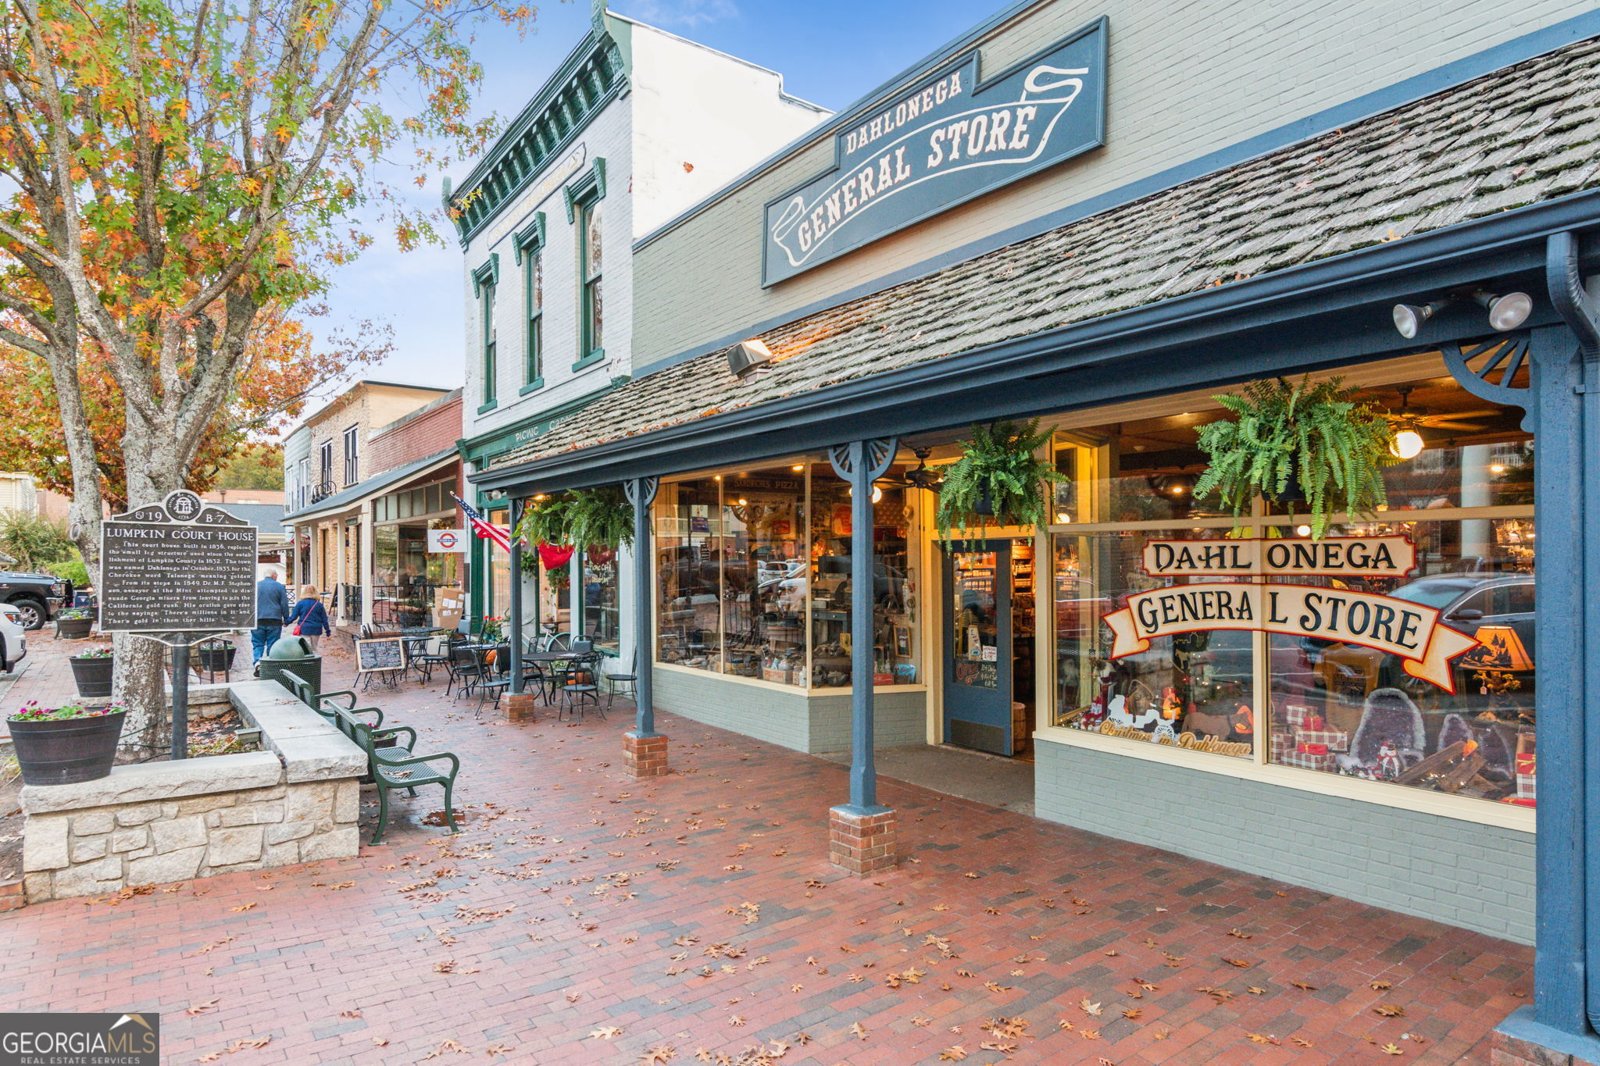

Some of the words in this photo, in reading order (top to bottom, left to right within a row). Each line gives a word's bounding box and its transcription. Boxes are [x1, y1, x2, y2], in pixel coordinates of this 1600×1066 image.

[847, 71, 962, 156] DAHLONEGA
[798, 147, 911, 252] GENERAL
[927, 106, 1038, 169] STORE
[515, 426, 539, 442] PICNIC
[107, 528, 165, 539] LUMPKIN
[171, 530, 213, 540] COURT
[218, 531, 255, 541] HOUSE
[1299, 592, 1422, 650] STORE
[1178, 731, 1251, 756] Dahlonega
